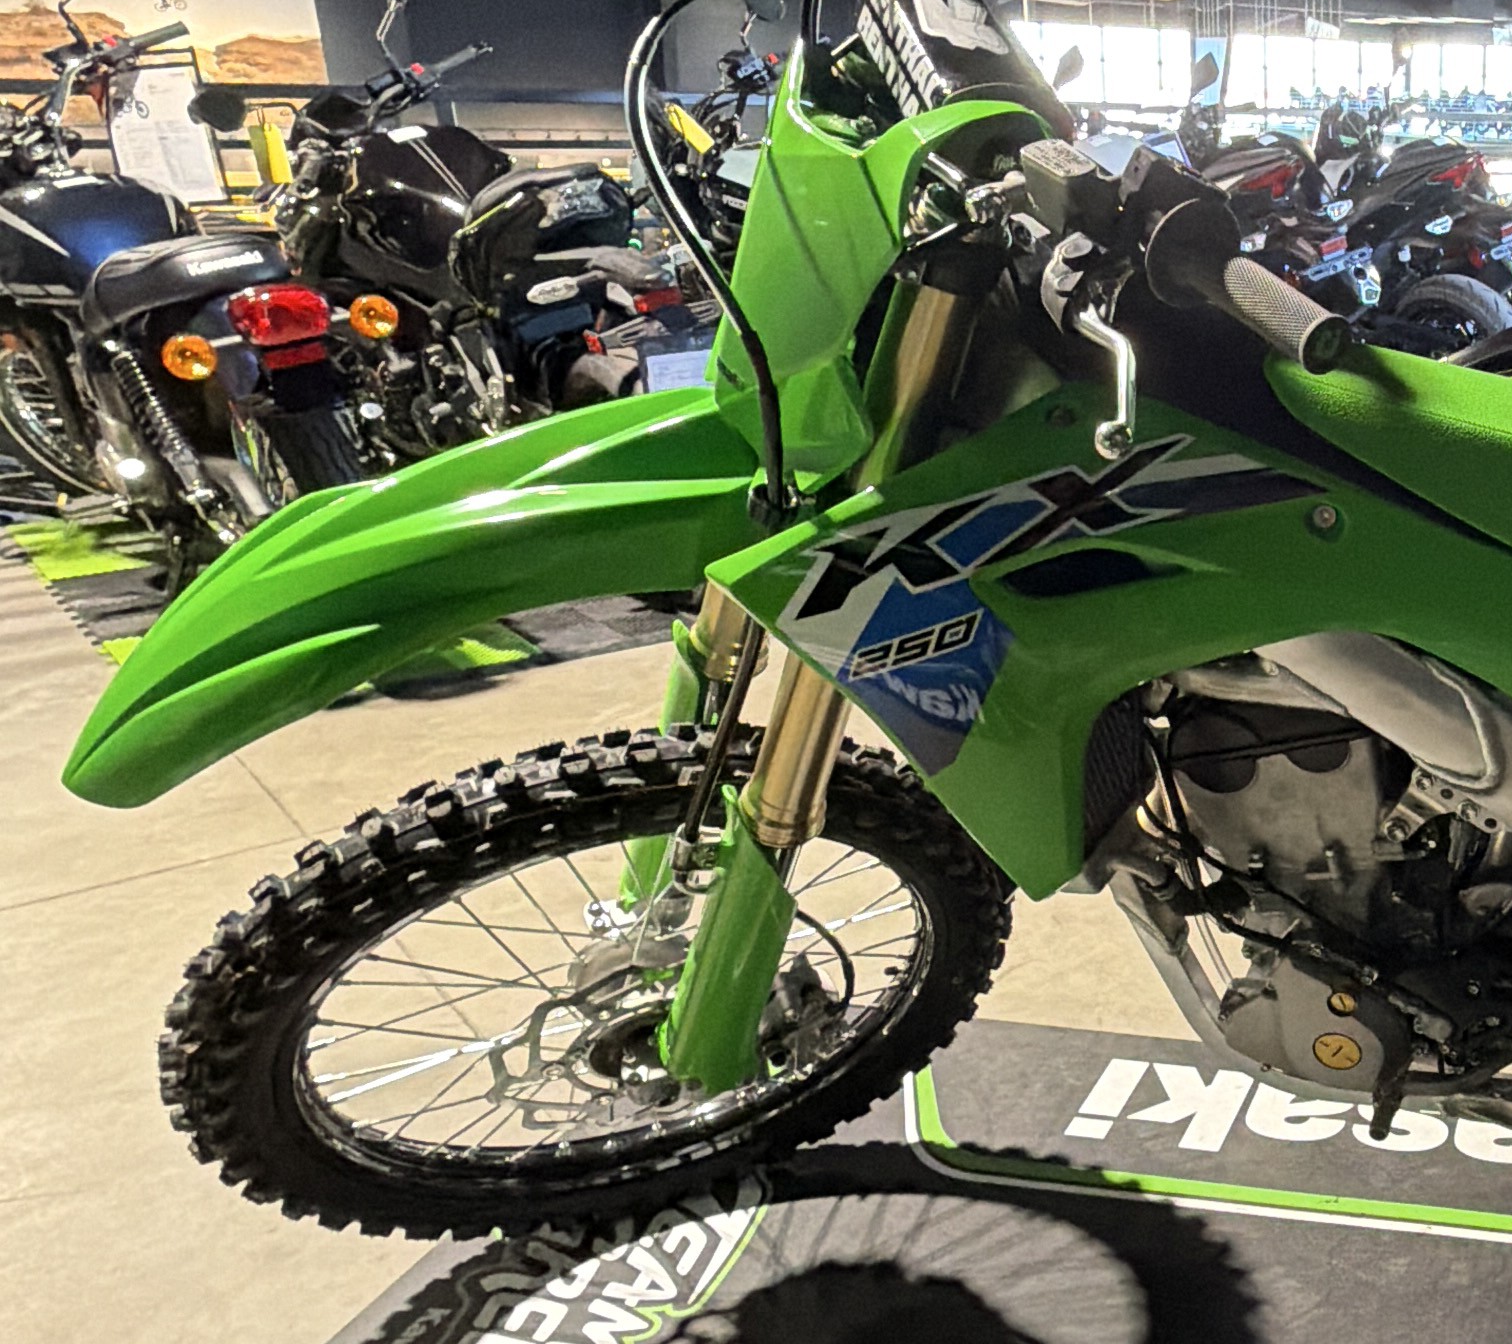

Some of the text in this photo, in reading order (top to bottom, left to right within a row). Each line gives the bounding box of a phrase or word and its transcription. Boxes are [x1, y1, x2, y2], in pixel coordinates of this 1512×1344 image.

[856, 3, 922, 119] RENTHA
[785, 434, 1162, 623] KX
[850, 610, 983, 681] 250
